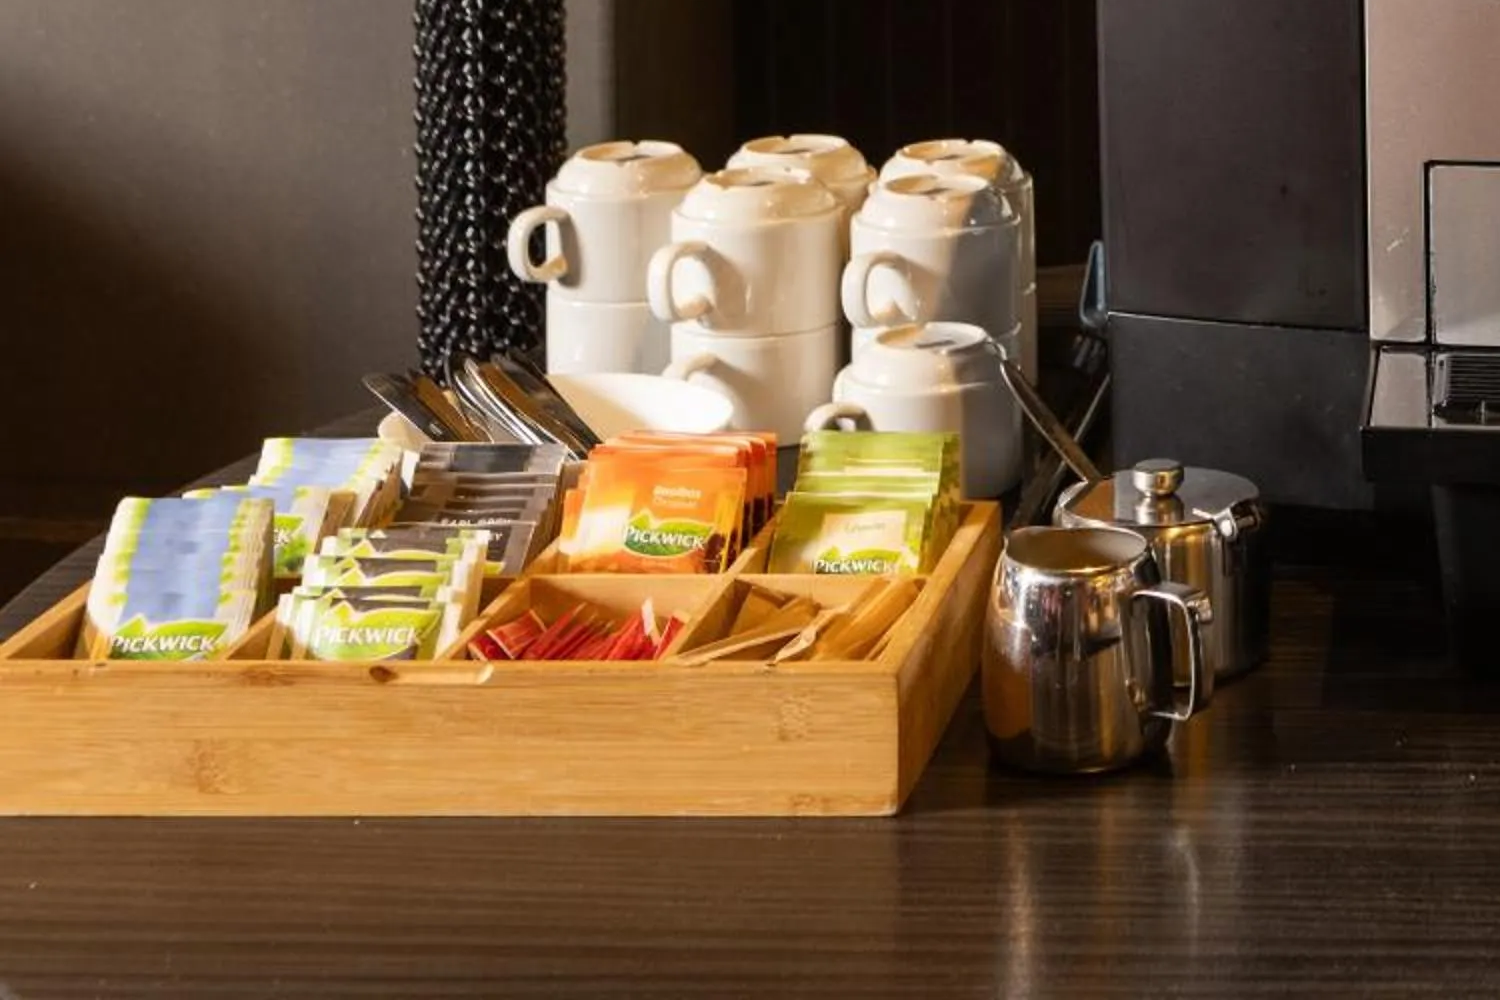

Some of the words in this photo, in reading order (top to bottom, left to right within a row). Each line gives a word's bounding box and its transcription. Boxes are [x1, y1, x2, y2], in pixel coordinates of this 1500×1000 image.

[623, 526, 705, 549] PICKWICK
[814, 559, 899, 574] PICKWICK
[111, 634, 217, 653] PICKWICK
[315, 627, 421, 649] PICKWICK
